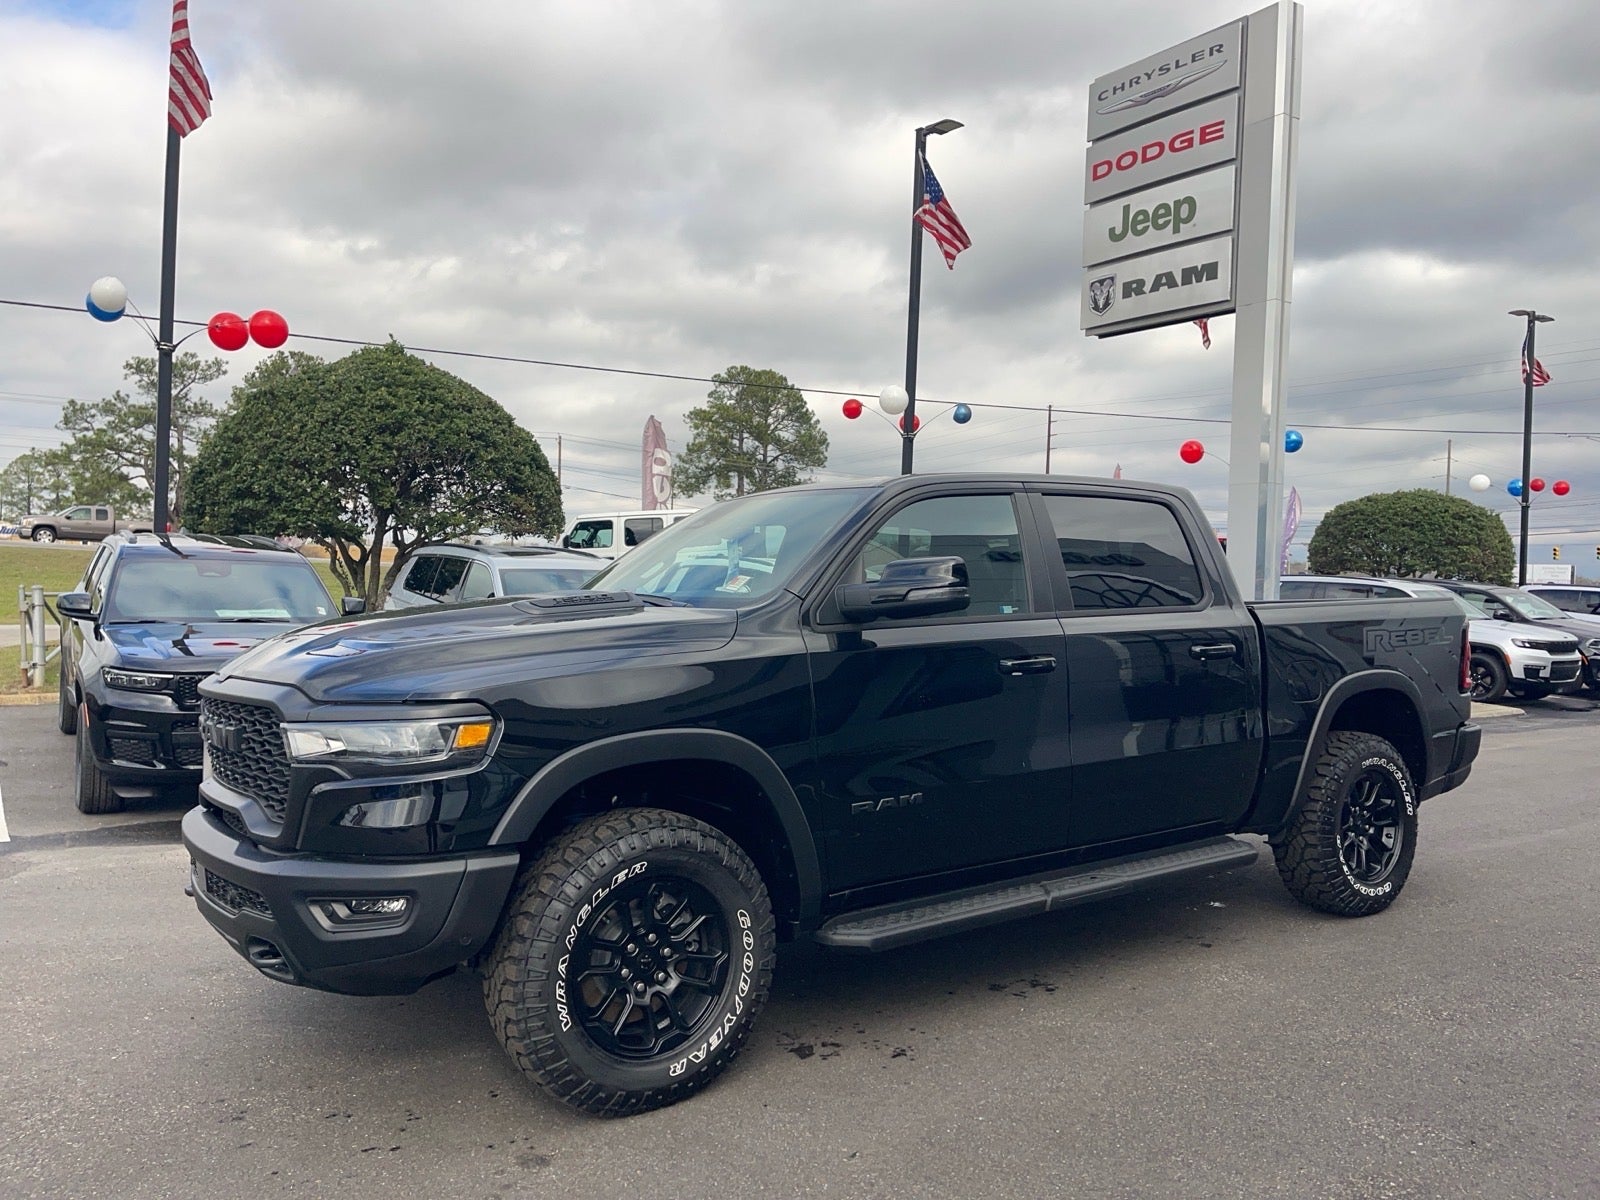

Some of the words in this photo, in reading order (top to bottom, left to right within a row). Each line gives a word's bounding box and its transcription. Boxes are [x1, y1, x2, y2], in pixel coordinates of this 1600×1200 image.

[1097, 43, 1225, 102] CHRYSLER
[1092, 119, 1226, 182] DODGE
[1108, 195, 1197, 243] Jeep
[1122, 261, 1219, 300] RAM
[1363, 626, 1454, 654] REBEL
[851, 792, 923, 815] RAM
[555, 861, 648, 1032] WRANGLER
[669, 909, 754, 1077] GOODYEAR
